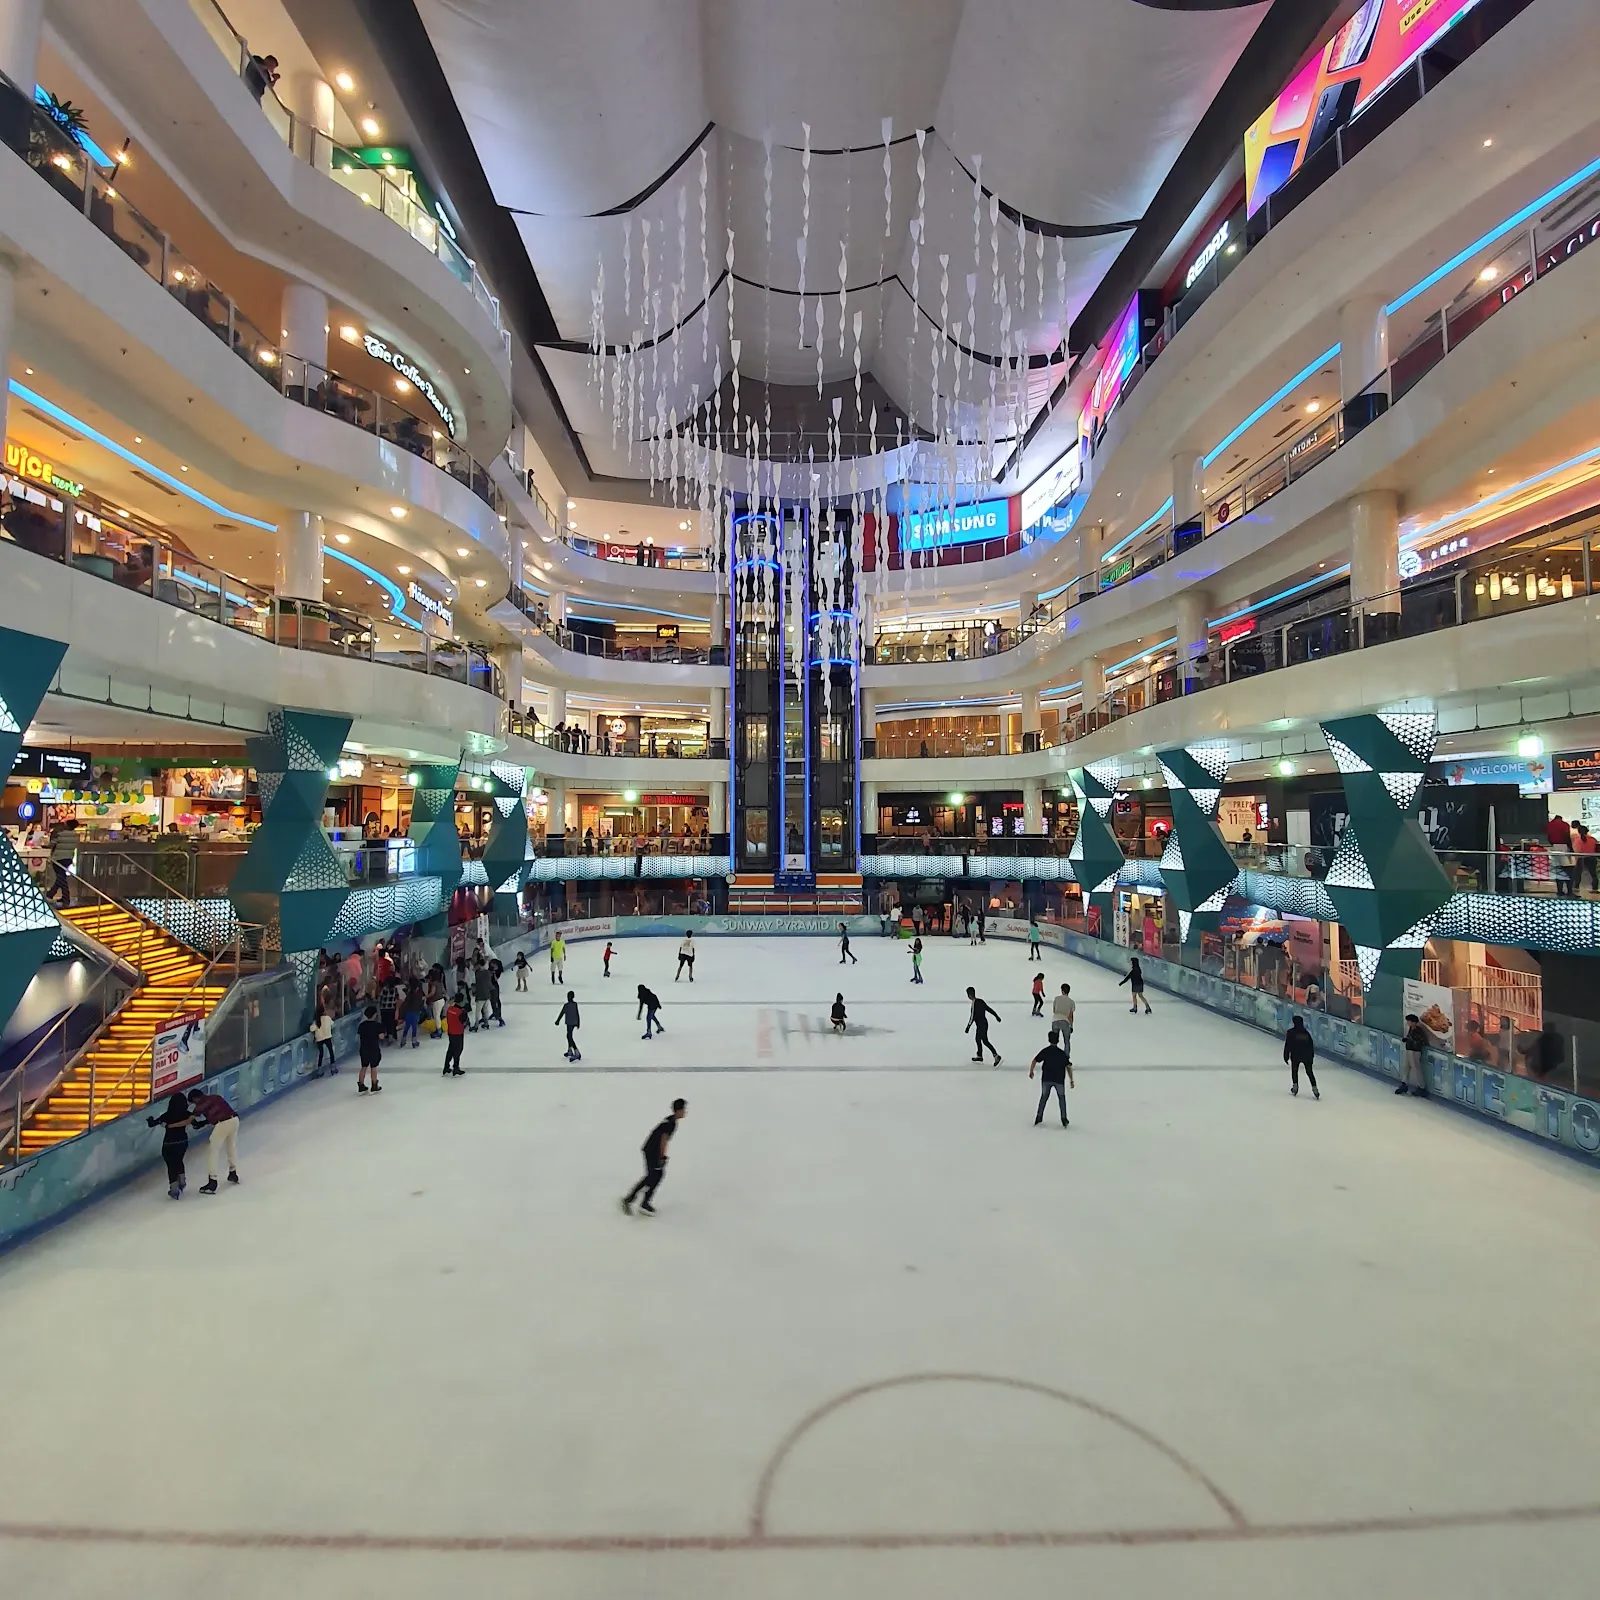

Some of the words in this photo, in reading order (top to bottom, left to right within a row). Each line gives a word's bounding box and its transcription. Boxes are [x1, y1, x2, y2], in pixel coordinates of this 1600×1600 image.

[1186, 220, 1229, 288] REMAX
[363, 335, 391, 362] The
[392, 353, 426, 391] Coffee
[1470, 763, 1525, 776] WELCOME
[1558, 760, 1576, 769] Thai
[721, 918, 773, 931] SUNWAY
[776, 919, 830, 931] PYRAMID
[1006, 924, 1029, 933] SUNWA
[168, 1050, 179, 1064] 10
[1426, 1049, 1508, 1120] THE
